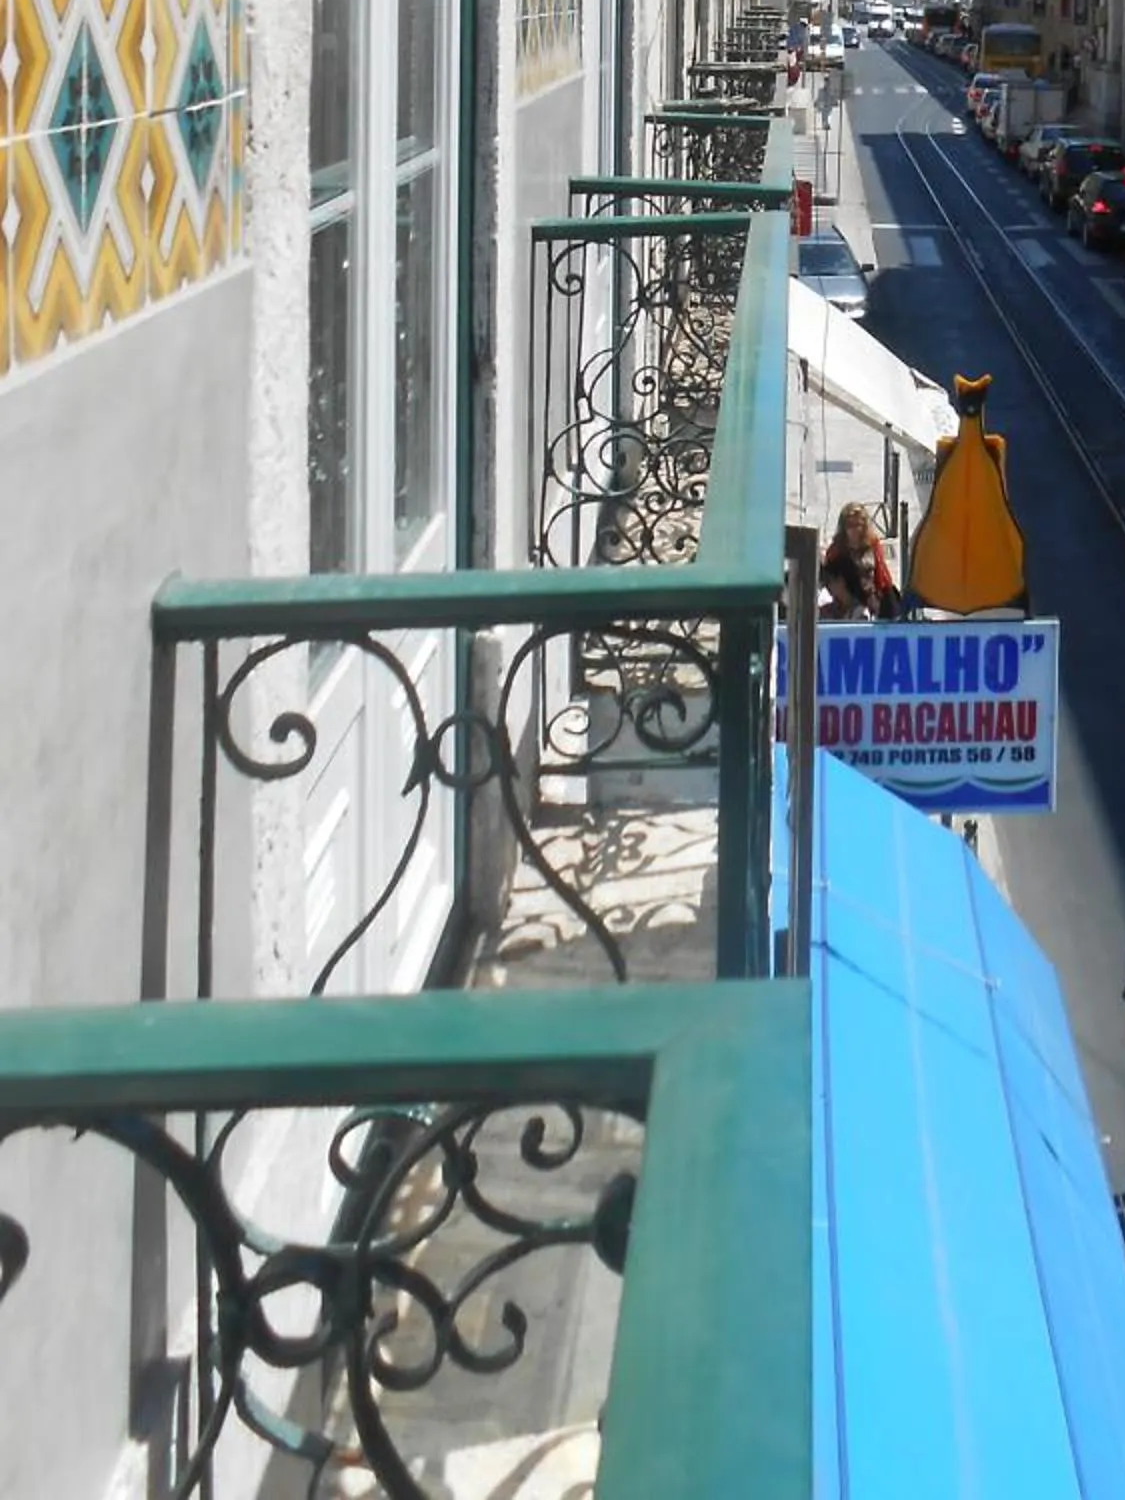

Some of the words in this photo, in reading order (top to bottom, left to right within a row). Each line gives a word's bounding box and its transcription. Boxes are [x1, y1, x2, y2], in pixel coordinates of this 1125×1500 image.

[776, 633, 1045, 696] MALHO”
[819, 704, 863, 746] DO
[871, 700, 1037, 744] BACALHAU
[888, 748, 962, 766] PORTAS
